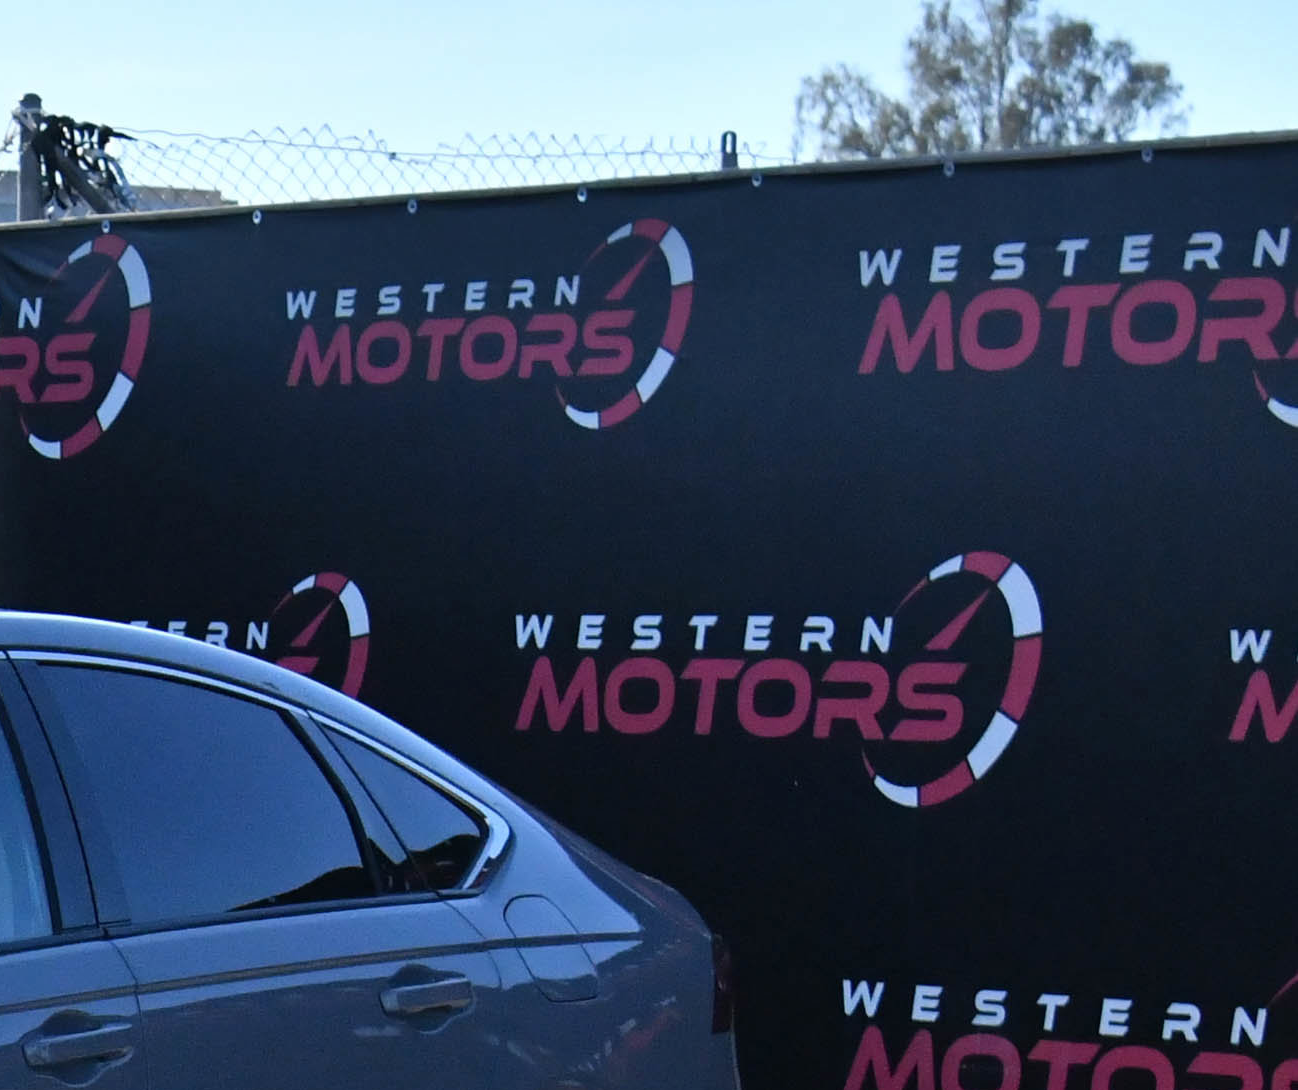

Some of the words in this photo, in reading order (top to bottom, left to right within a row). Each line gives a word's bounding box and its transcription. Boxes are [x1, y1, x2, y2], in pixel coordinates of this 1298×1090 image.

[859, 227, 1290, 288] WESTERN
[286, 275, 580, 321] WESTERN
[857, 277, 1298, 374] MOTOR
[286, 309, 635, 387] MOTORS
[515, 614, 893, 654] WESTERN
[514, 656, 967, 742] MOTORS
[842, 979, 1267, 1046] WESTERN
